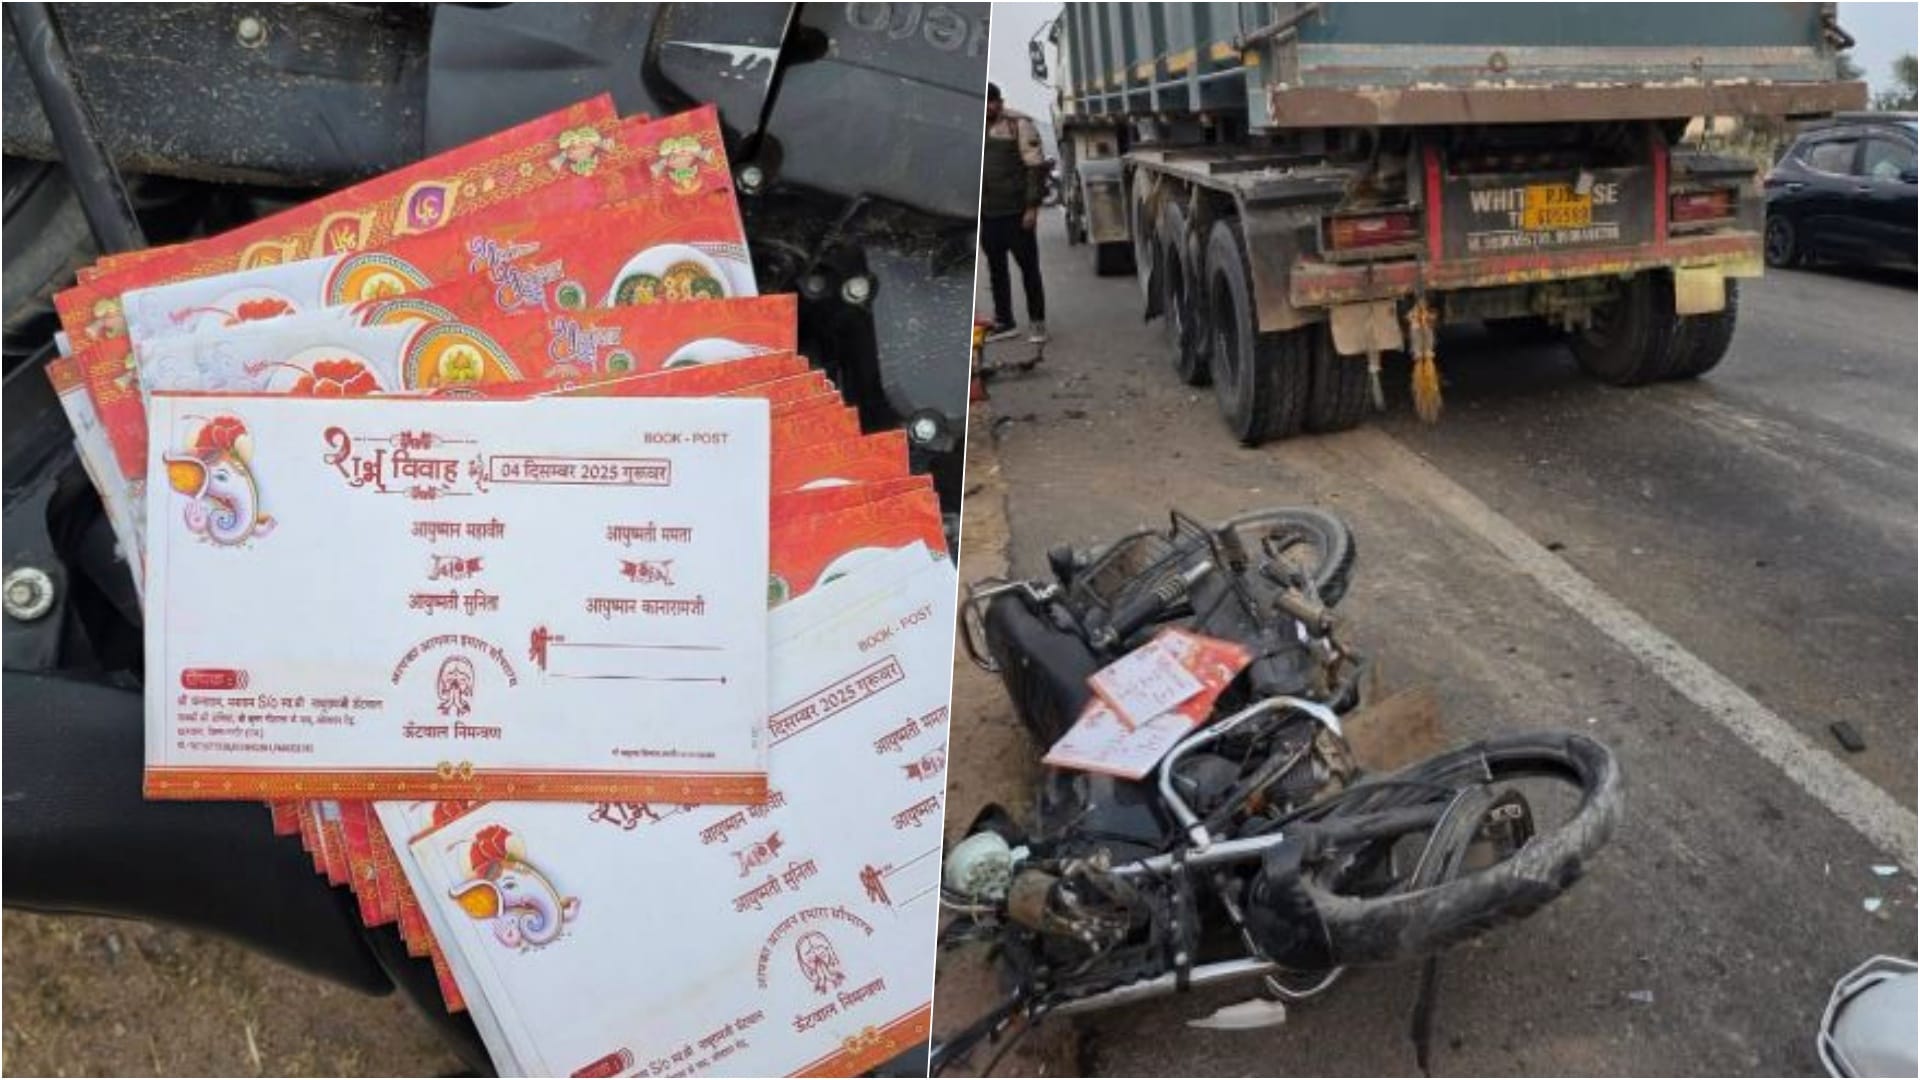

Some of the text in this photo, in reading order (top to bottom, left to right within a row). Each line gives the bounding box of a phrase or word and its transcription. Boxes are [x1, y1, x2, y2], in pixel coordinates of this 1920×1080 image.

[1470, 187, 1525, 213] WHIT
[643, 432, 682, 444] BOOK
[692, 432, 729, 445] POST
[391, 449, 459, 488] विवाह
[501, 464, 520, 478] 04
[582, 465, 618, 481] 2025
[661, 527, 693, 543] ममता
[858, 625, 894, 652] BOOK
[899, 604, 933, 629] POST
[819, 684, 857, 712] 2025
